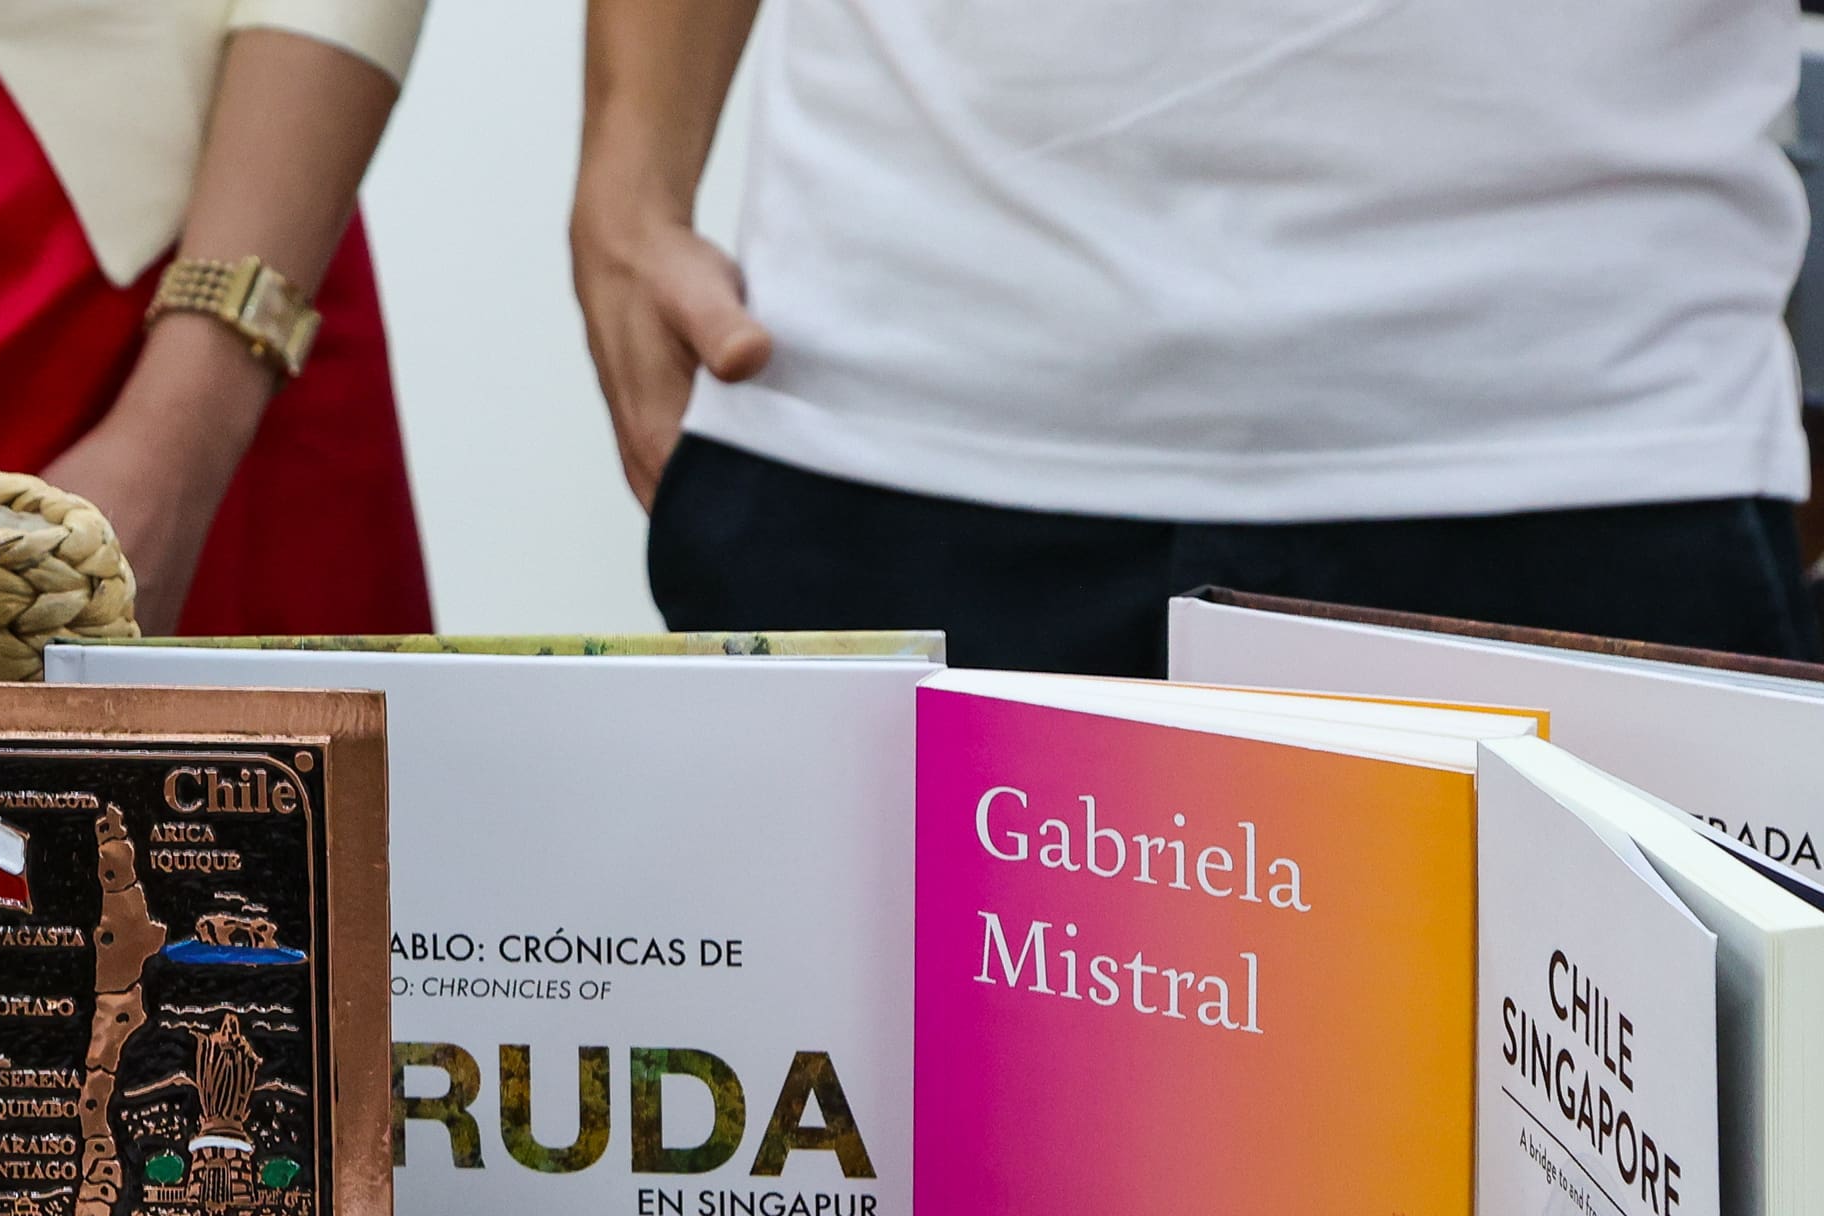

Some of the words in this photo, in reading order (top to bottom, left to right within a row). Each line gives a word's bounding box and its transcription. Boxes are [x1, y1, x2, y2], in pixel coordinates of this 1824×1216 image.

[164, 768, 298, 815] Chile
[150, 821, 216, 842] ARICA
[975, 785, 1312, 912] Gabriela
[1689, 815, 1823, 871] ADA
[150, 849, 242, 873] IQUIQUE
[498, 928, 686, 967] CRÓNICAS
[700, 939, 744, 968] DE
[973, 910, 1264, 1034] Mistral
[422, 976, 571, 1000] CHRONICLES
[579, 980, 612, 1001] OF
[1548, 949, 1633, 1093] CHILE
[391, 1041, 878, 1179] RUDA
[1519, 1127, 1528, 1148] A
[1528, 1135, 1557, 1185] bridge
[1559, 1168, 1568, 1191] to
[1569, 1183, 1584, 1211] and
